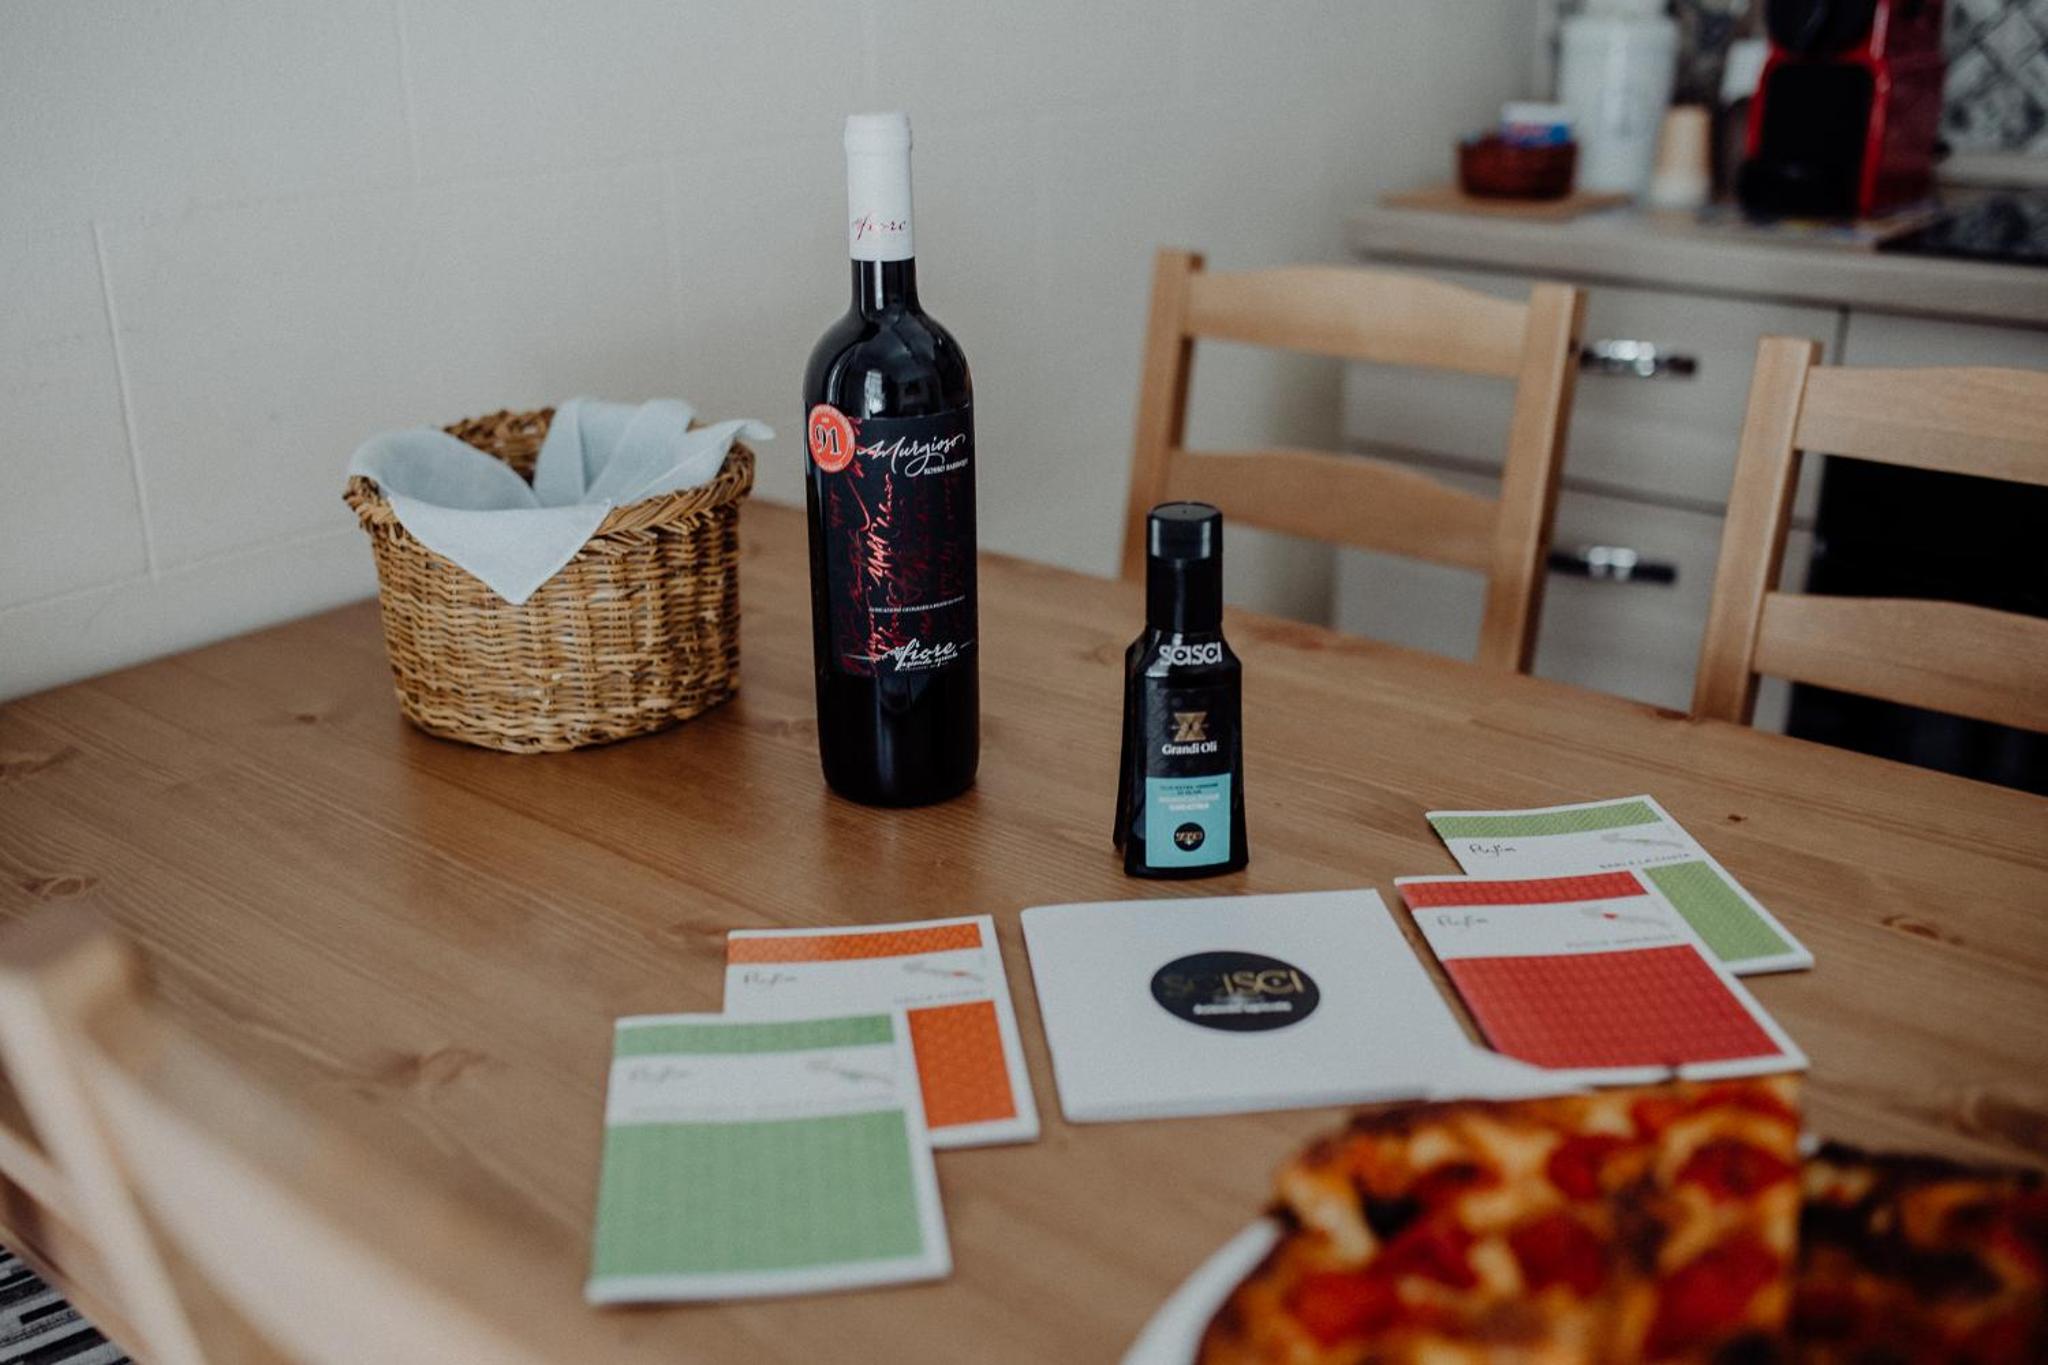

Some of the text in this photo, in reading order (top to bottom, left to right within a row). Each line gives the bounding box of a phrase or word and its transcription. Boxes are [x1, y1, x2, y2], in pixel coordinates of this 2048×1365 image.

[814, 423, 842, 456] 91
[1161, 740, 1218, 756] Grandi Oli
